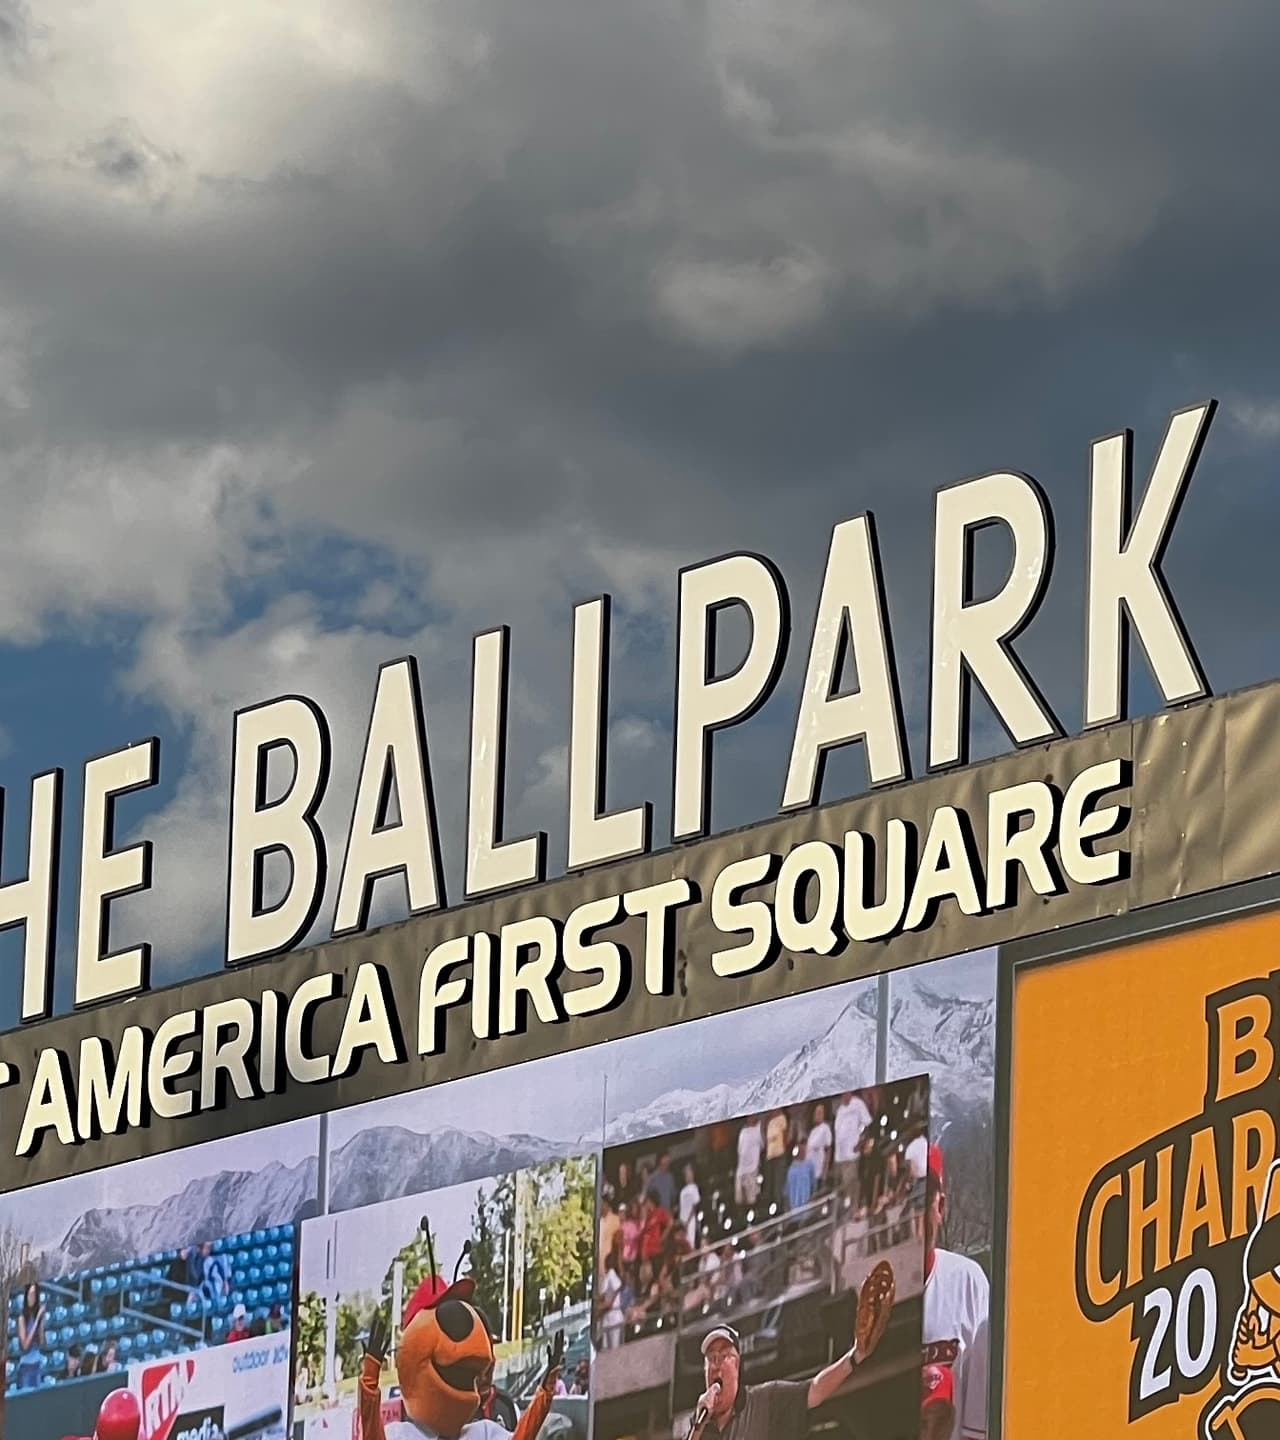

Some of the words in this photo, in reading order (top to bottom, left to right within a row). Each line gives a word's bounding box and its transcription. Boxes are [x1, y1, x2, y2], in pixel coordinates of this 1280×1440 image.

[224, 400, 1216, 967] BALLPARK
[13, 970, 406, 1158] AMERICA
[417, 876, 701, 1055] FIRST
[710, 757, 1131, 978] SQUARE
[1139, 1267, 1218, 1400] 20
